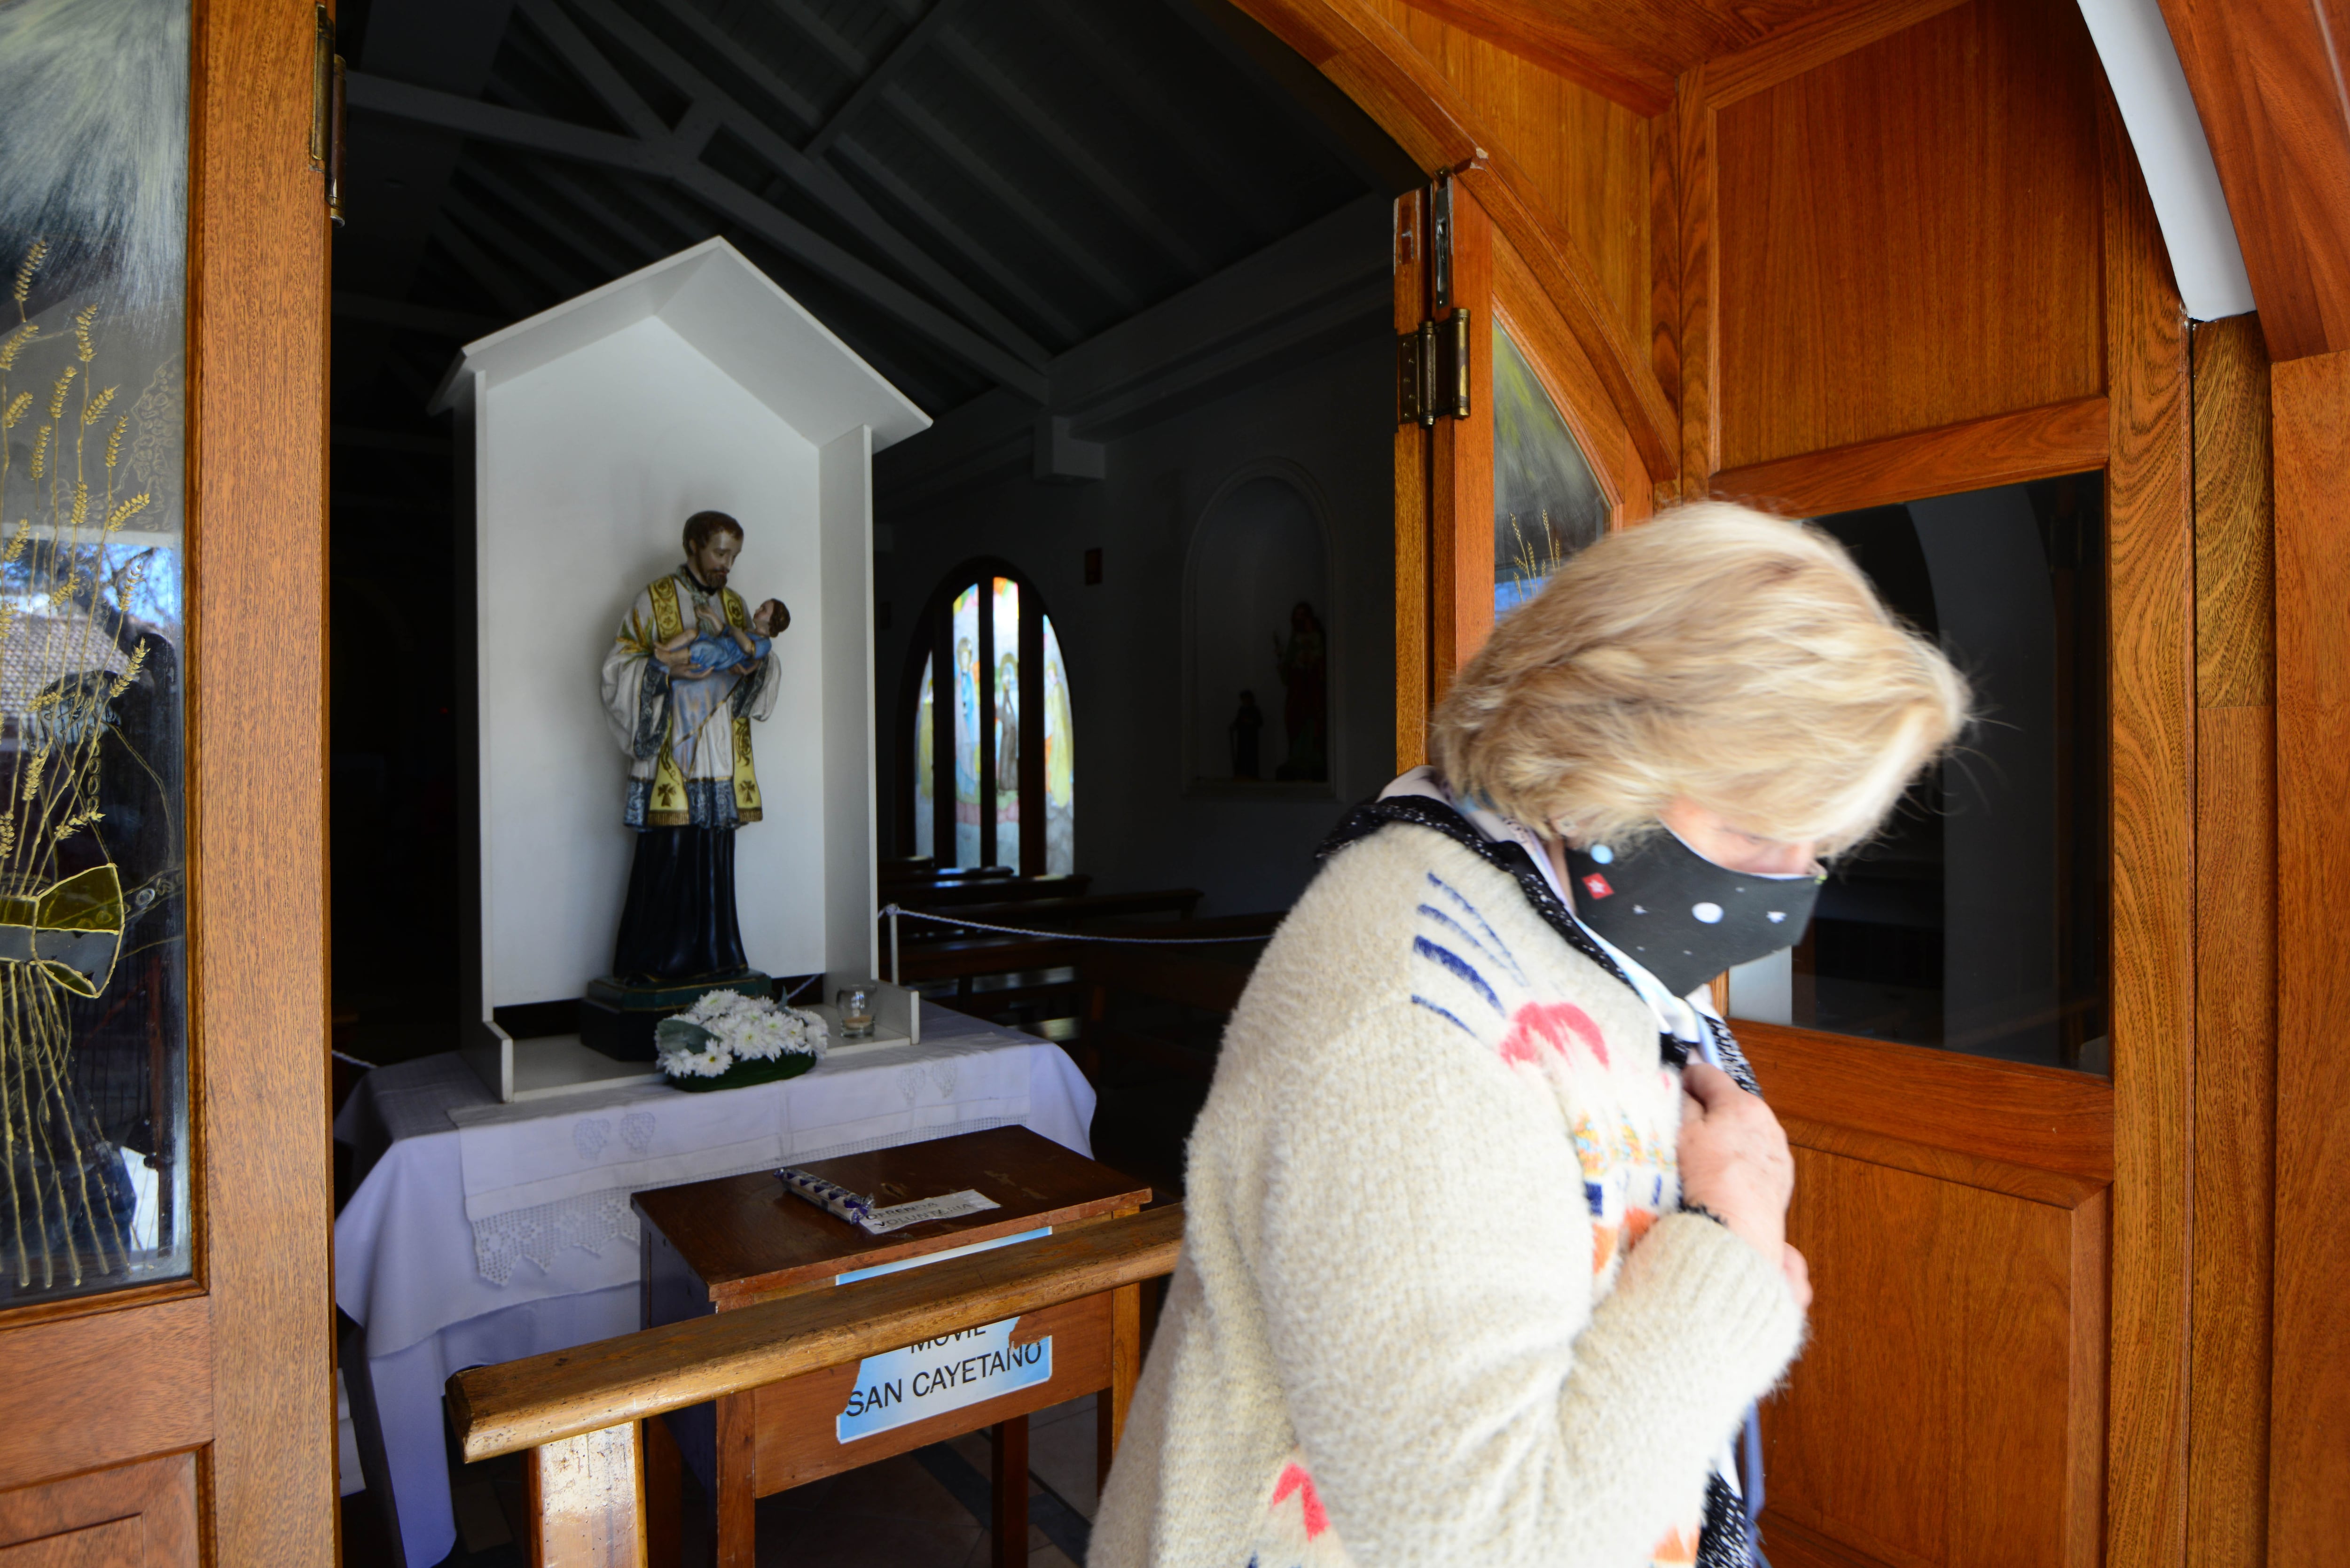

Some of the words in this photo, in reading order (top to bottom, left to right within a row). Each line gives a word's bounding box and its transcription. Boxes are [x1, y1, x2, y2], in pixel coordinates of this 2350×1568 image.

[866, 1201, 938, 1220] OFRENDA
[874, 1203, 973, 1229] VOLUNTARIA
[846, 1378, 902, 1417] SAN
[913, 1342, 1042, 1397] CAYETANO
